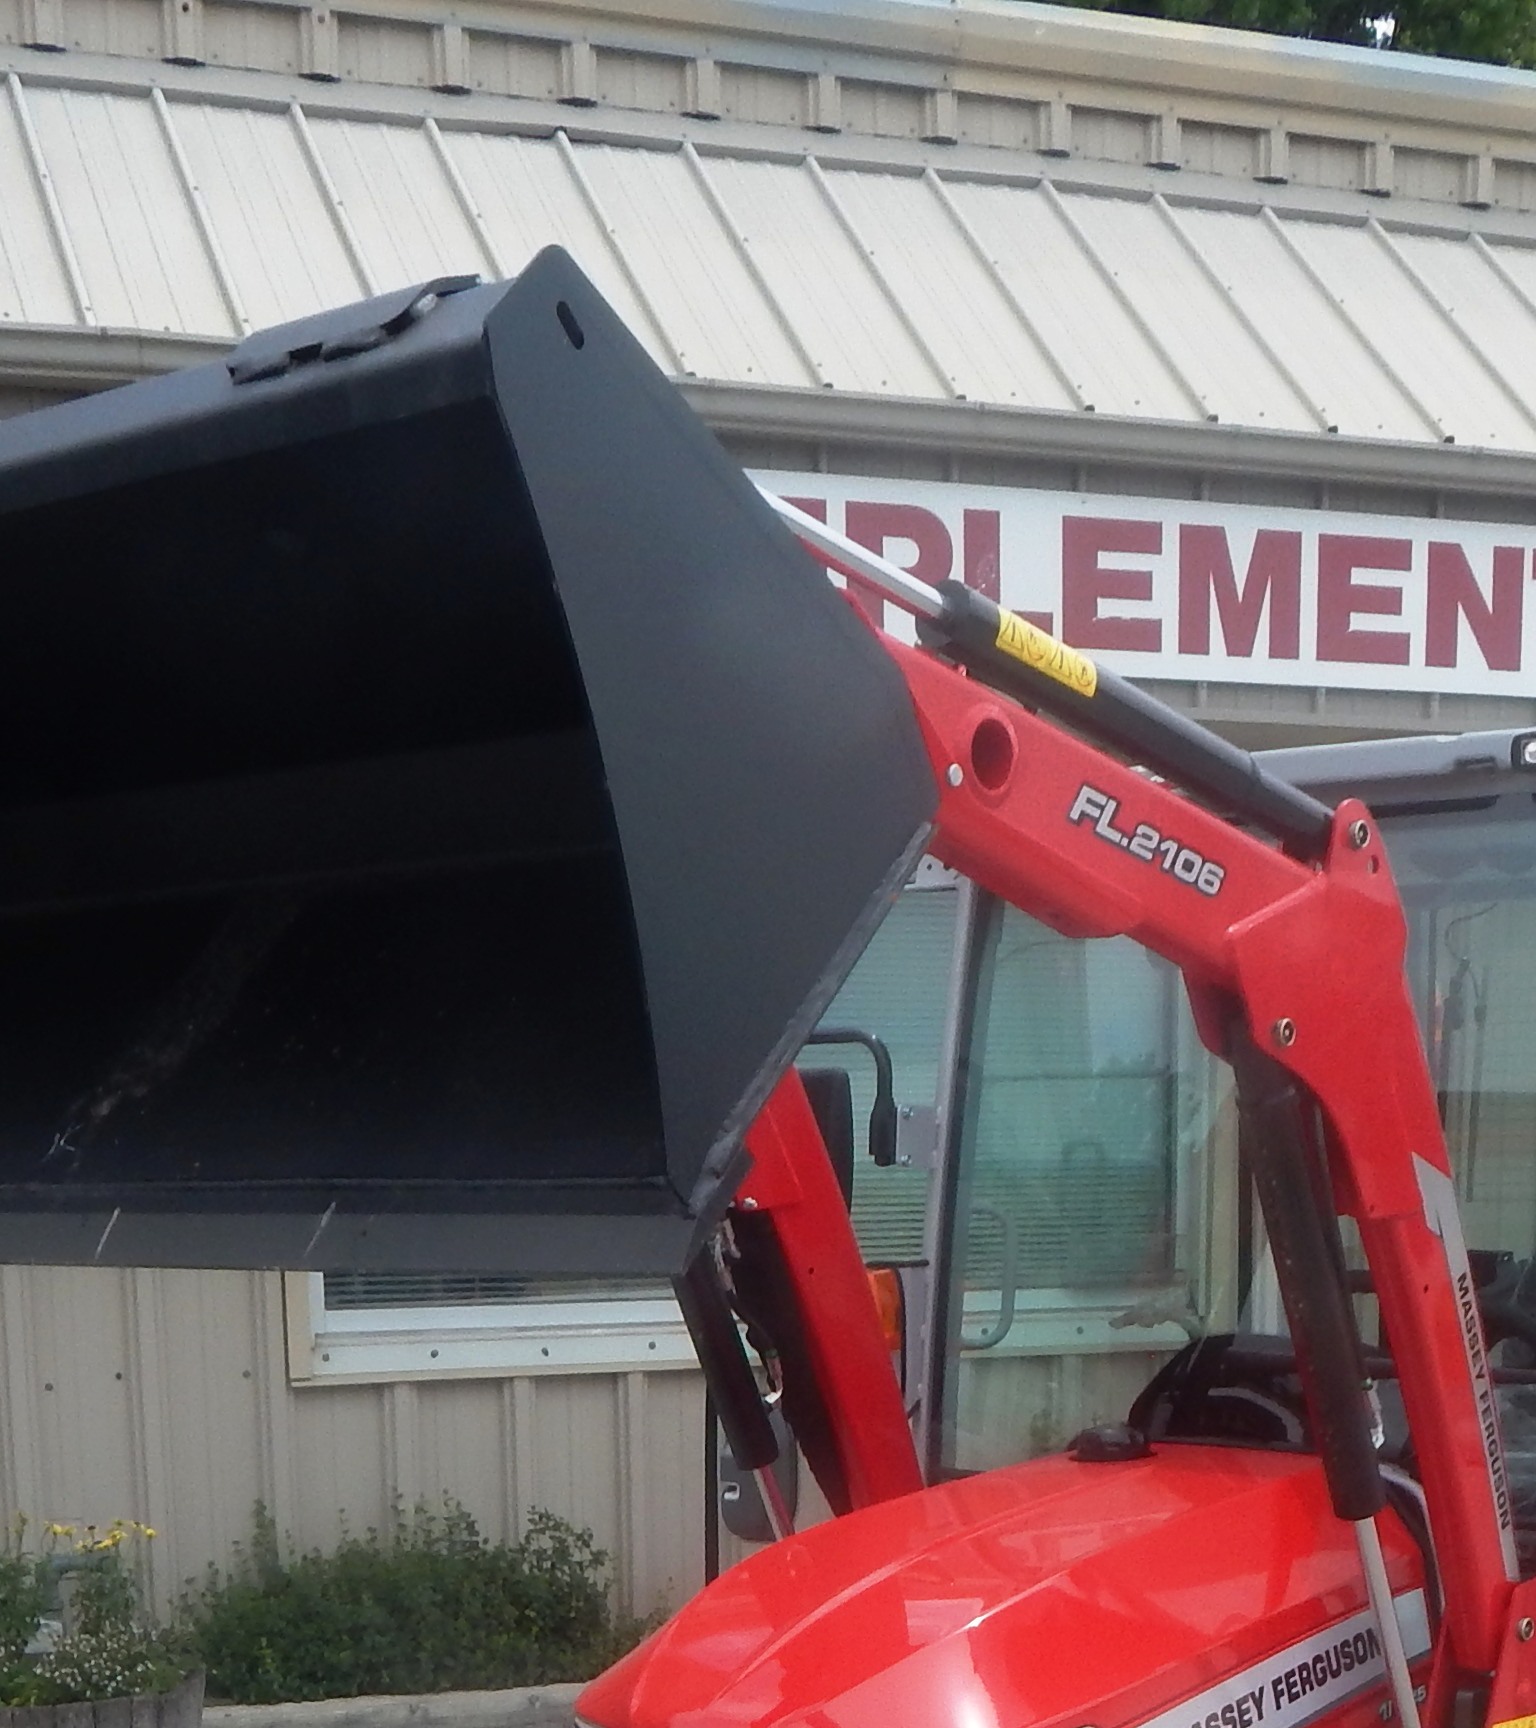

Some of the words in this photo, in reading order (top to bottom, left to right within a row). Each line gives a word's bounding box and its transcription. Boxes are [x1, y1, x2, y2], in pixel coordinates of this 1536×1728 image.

[1068, 783, 1227, 896] FL.2106
[1456, 1271, 1485, 1379] MASSEY
[1479, 1390, 1511, 1531] FERGUSON
[1270, 1627, 1383, 1712] FERGUSON
